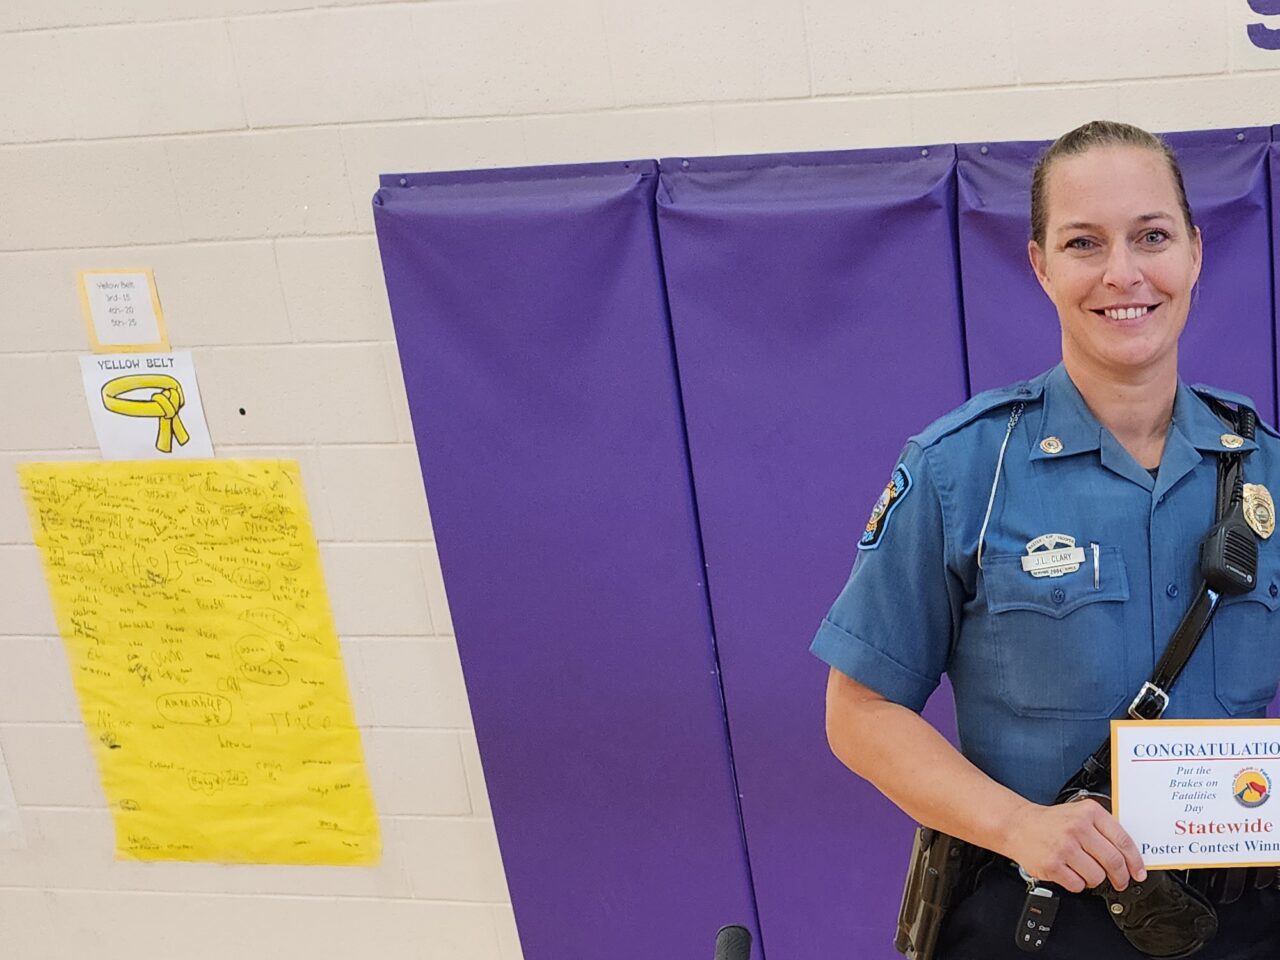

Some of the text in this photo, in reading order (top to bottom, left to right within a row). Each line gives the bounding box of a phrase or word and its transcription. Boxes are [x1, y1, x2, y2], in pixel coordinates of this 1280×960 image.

[98, 358, 175, 370] YELLOW BELT
[1051, 553, 1072, 563] CLARY
[1176, 766, 1211, 775] Put the
[1169, 778, 1203, 788] Brakes
[1171, 790, 1217, 800] Fatalities
[1184, 803, 1203, 814] Day
[1174, 818, 1274, 835] Statewide
[1141, 843, 1184, 855] Poster
[1188, 841, 1240, 854] Contest
